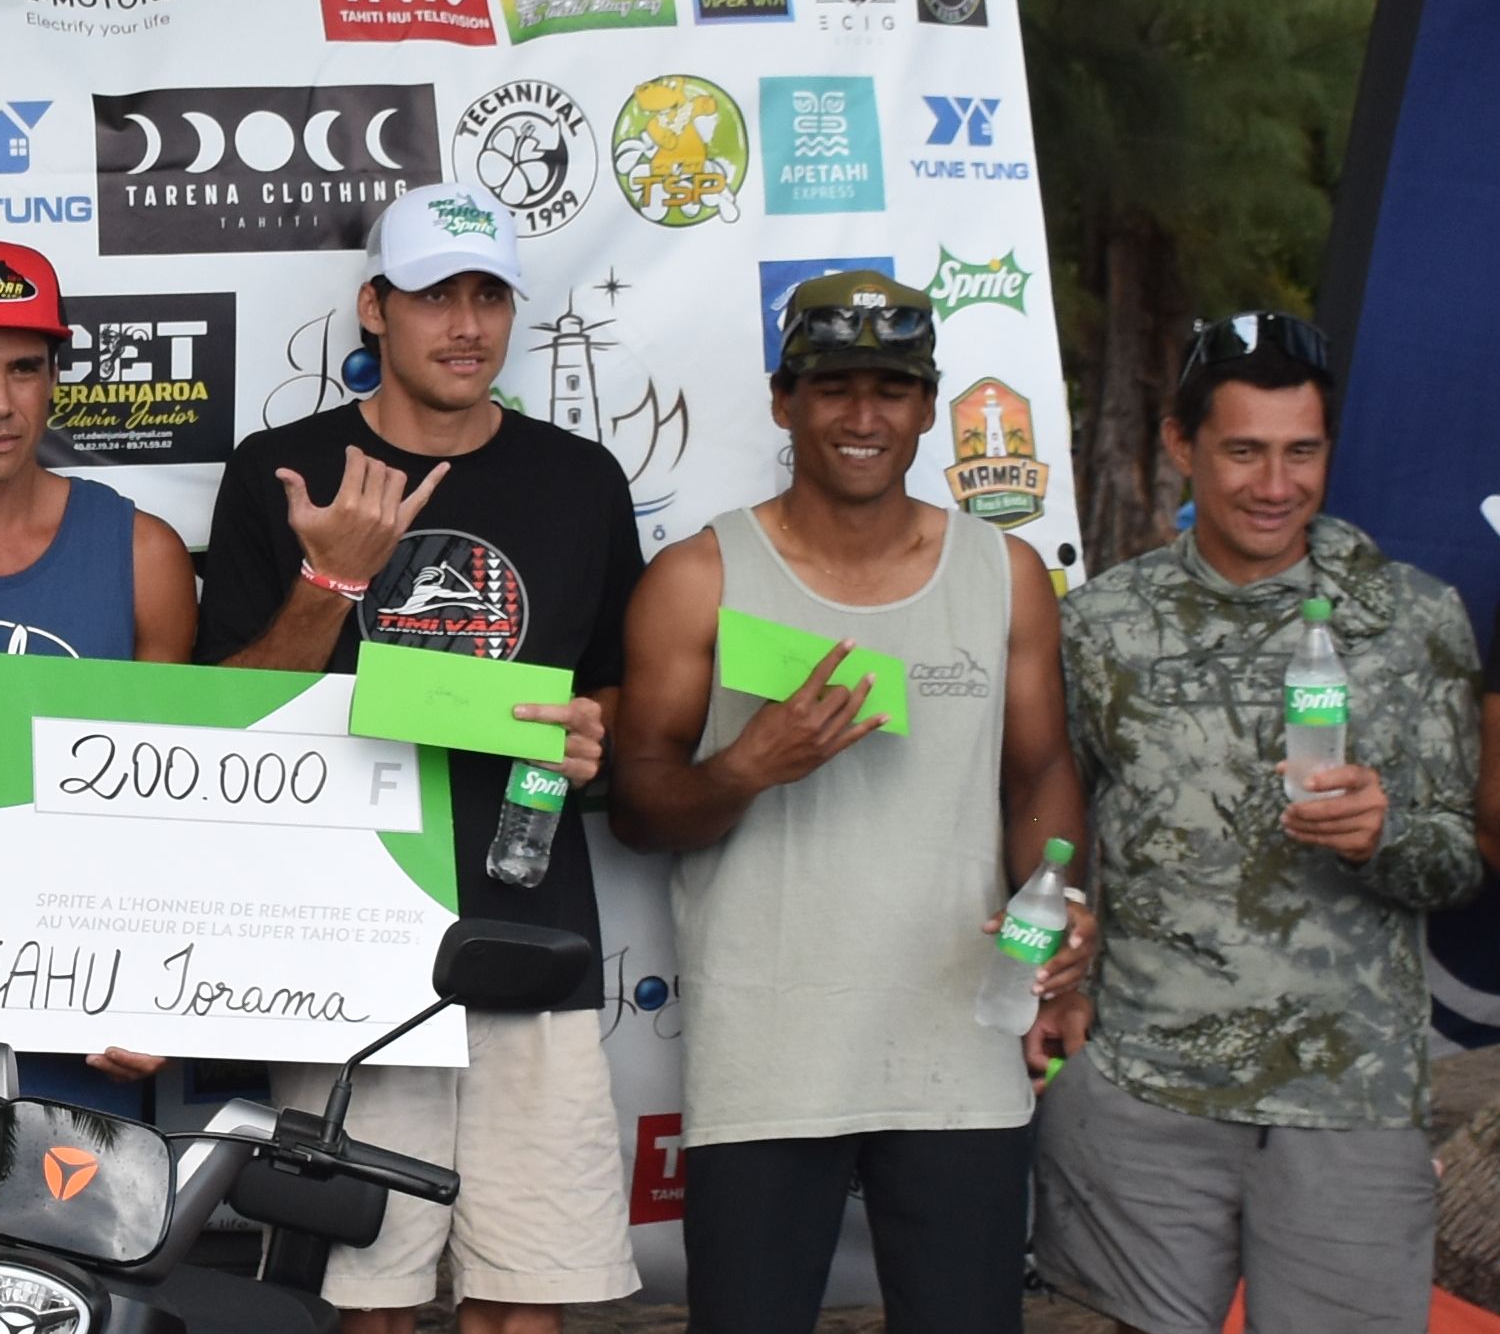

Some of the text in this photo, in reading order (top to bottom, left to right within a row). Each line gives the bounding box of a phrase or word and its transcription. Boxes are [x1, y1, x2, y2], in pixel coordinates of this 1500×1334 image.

[26, 12, 171, 37] Electrify your life
[341, 11, 491, 29] TAHITI NUI TELEVISION
[457, 83, 585, 138] TECHNIVAL
[780, 164, 868, 183] APETAHI
[910, 160, 1029, 180] YUNE TUNG
[126, 178, 408, 207] TARENA CLOTHING
[633, 171, 727, 207] TSP
[793, 186, 855, 200] EXPRESS
[220, 216, 319, 230] TAHITI
[527, 190, 580, 231] 1999
[931, 258, 1022, 307] Sprite
[52, 381, 209, 404] ERAIHAROA
[47, 398, 200, 430] Edwin Junior
[957, 462, 1040, 493] MAMA'S
[377, 614, 440, 631] TIMI
[377, 626, 445, 636] TAHITIAN
[60, 734, 328, 805] 200.000
[368, 760, 403, 806] F
[36, 893, 426, 924] SPRITE A L'HONNEUR DE REMETTRE CE PRIX
[36, 915, 64, 930] AU
[68, 916, 177, 936] VAINQUEUR
[181, 921, 207, 936] DE
[211, 922, 234, 937] LA
[238, 923, 294, 940] SUPER
[300, 926, 366, 944] TAHO'E
[370, 928, 411, 945] 2025
[651, 1188, 685, 1202] TAHI
